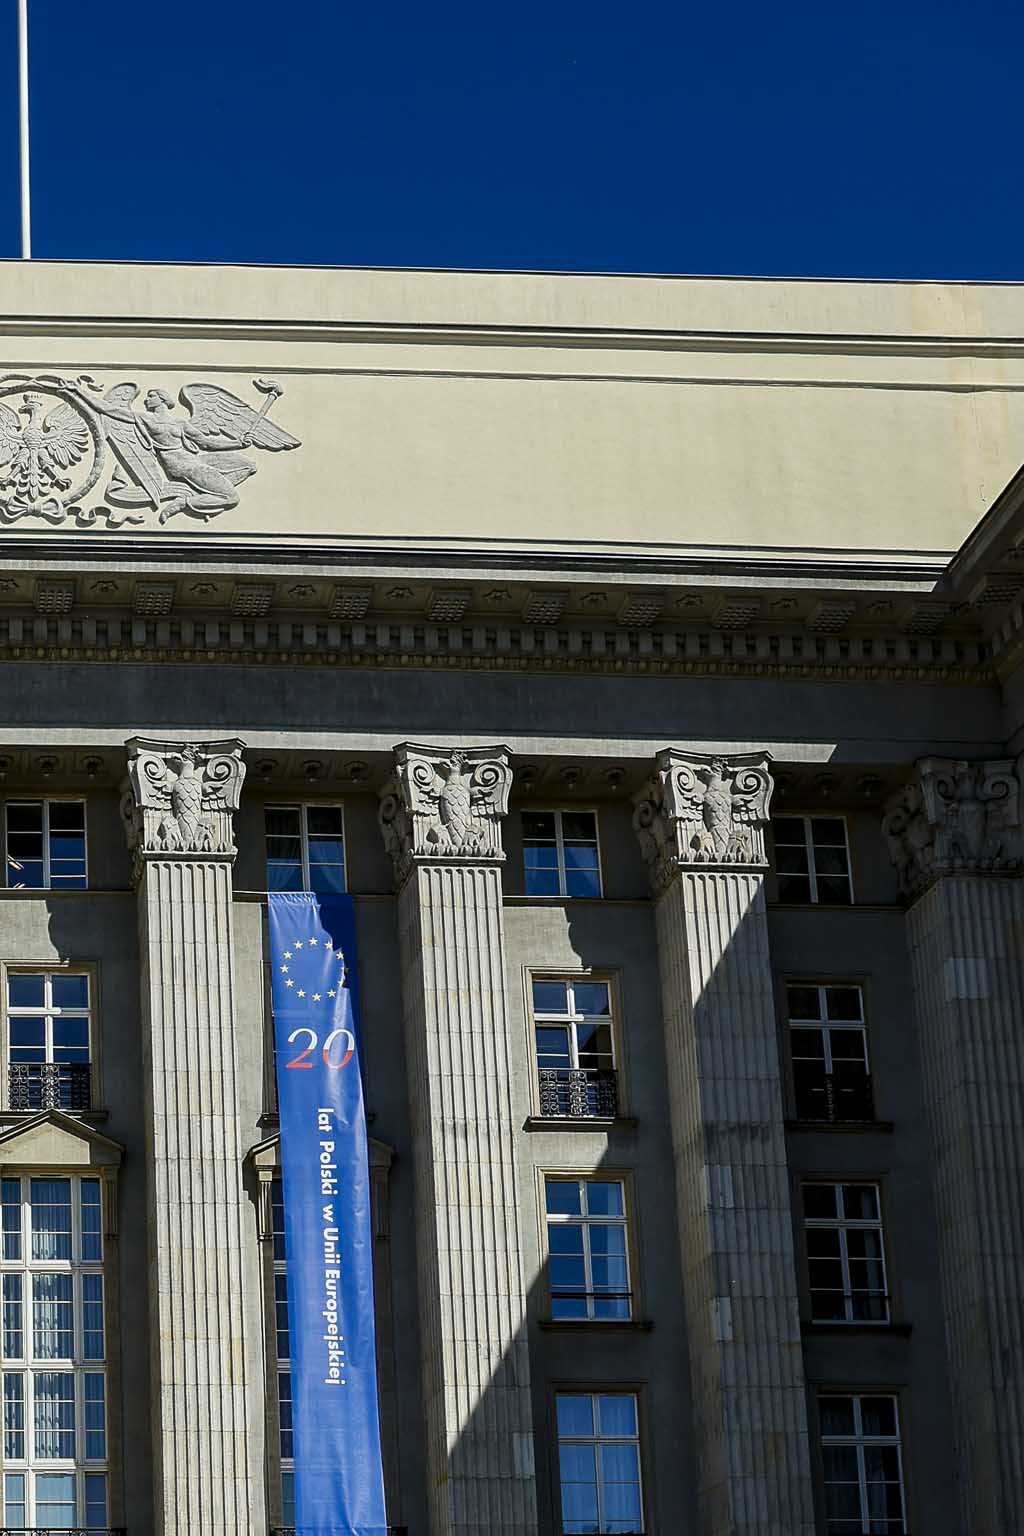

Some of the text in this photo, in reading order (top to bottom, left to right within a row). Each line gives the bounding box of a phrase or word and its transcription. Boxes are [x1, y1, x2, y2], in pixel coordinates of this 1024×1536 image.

[284, 1028, 355, 1070] 20
[318, 1108, 346, 1386] lat Polski w Unii Europejskiej
